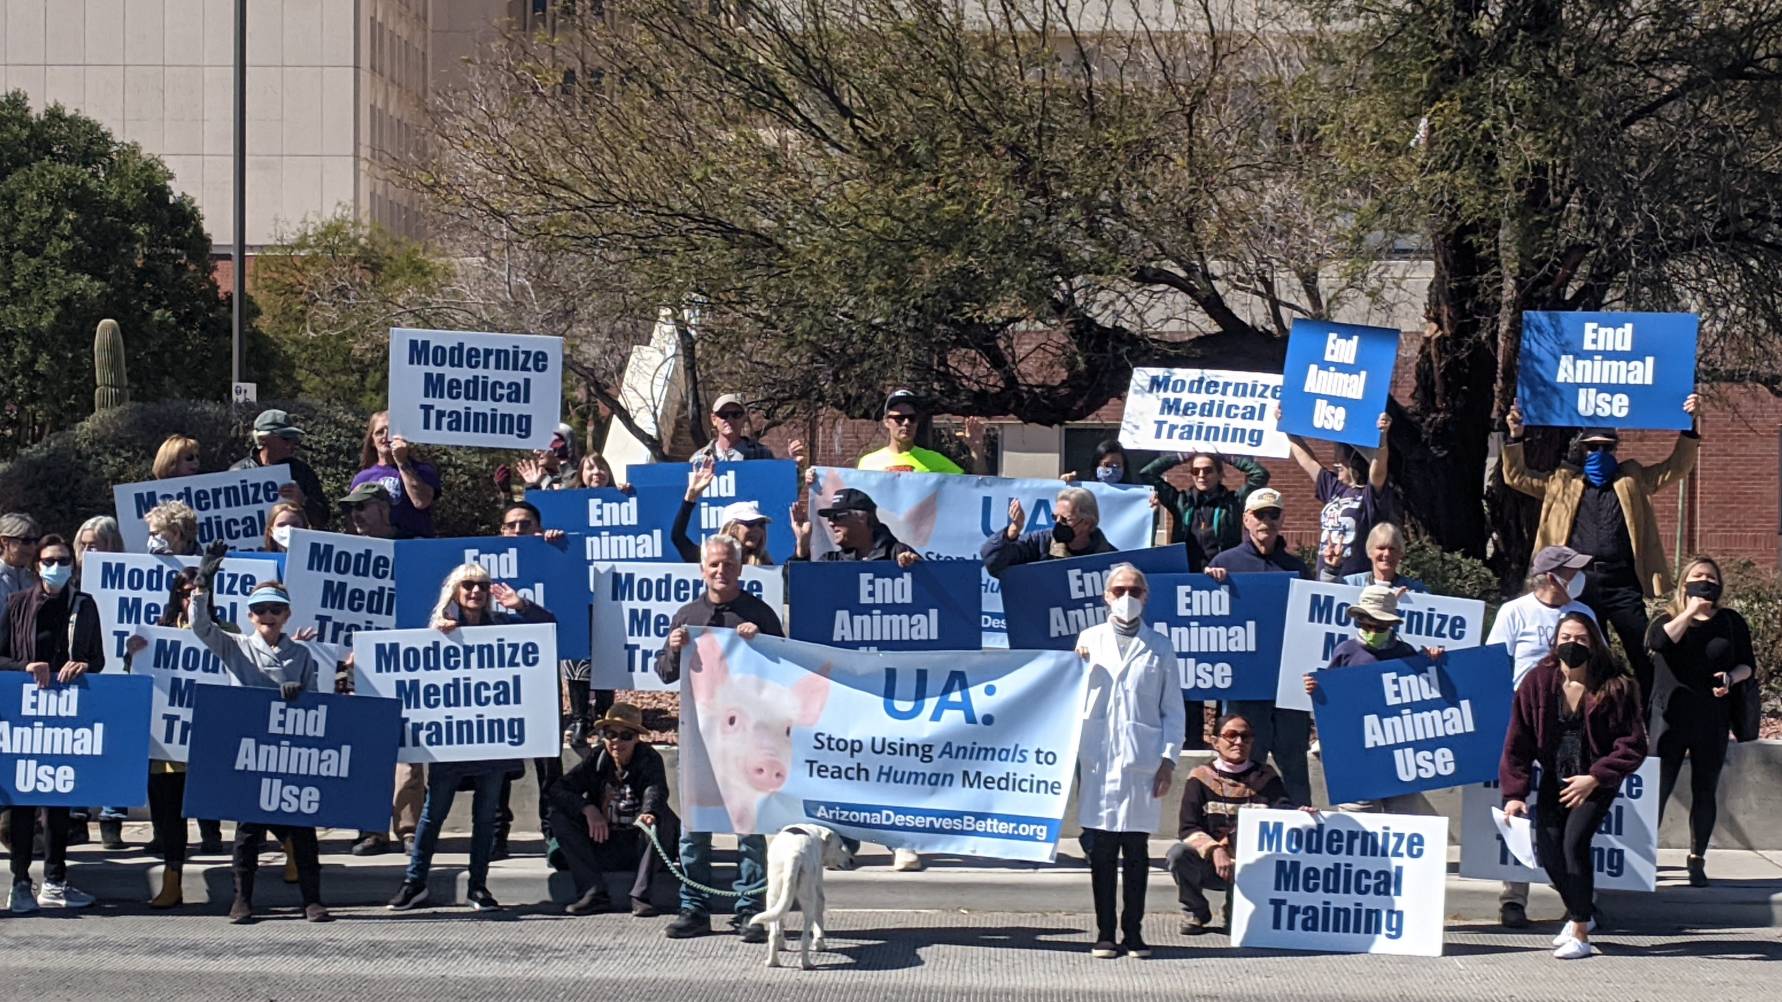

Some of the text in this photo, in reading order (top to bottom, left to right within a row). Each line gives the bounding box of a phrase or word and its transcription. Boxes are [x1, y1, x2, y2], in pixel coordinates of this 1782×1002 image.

[1324, 332, 1360, 365] End
[1583, 322, 1633, 351] End
[408, 339, 549, 373] Modernize
[1556, 354, 1656, 385] Animal
[423, 372, 531, 404] Medical
[1148, 375, 1283, 400] Modernize
[1303, 363, 1367, 400] Animal
[1158, 397, 1268, 421] Medical
[1312, 398, 1347, 432] Use
[1577, 388, 1630, 418] Use
[420, 404, 533, 440] Training
[1153, 420, 1265, 448] Training
[688, 470, 736, 498] nd
[588, 497, 638, 527] End
[586, 529, 663, 560] nimal
[101, 562, 257, 596] Modeize
[611, 572, 763, 602] Modere
[859, 572, 913, 604] End
[320, 579, 396, 616] Medi
[1176, 585, 1230, 617] End
[832, 608, 939, 642] Animal
[375, 638, 540, 674] Modernize
[1176, 657, 1233, 690] Use
[1381, 666, 1443, 706] End
[21, 683, 79, 717] End
[395, 674, 522, 710] Medical
[883, 667, 997, 726] UA:
[268, 700, 328, 738] End
[1363, 699, 1475, 749] Animal
[234, 737, 352, 778] Animal
[812, 732, 1058, 766] Stop Using Animals to
[1393, 747, 1456, 782] Use
[15, 759, 75, 793] Use
[805, 760, 1063, 795] Teach Human Medicine
[259, 777, 321, 814] Use
[816, 805, 1049, 840] ArizonaDeservesBetter.org
[1257, 821, 1425, 859] Modernize
[1273, 859, 1404, 897] Medical
[1268, 898, 1405, 940] Training
